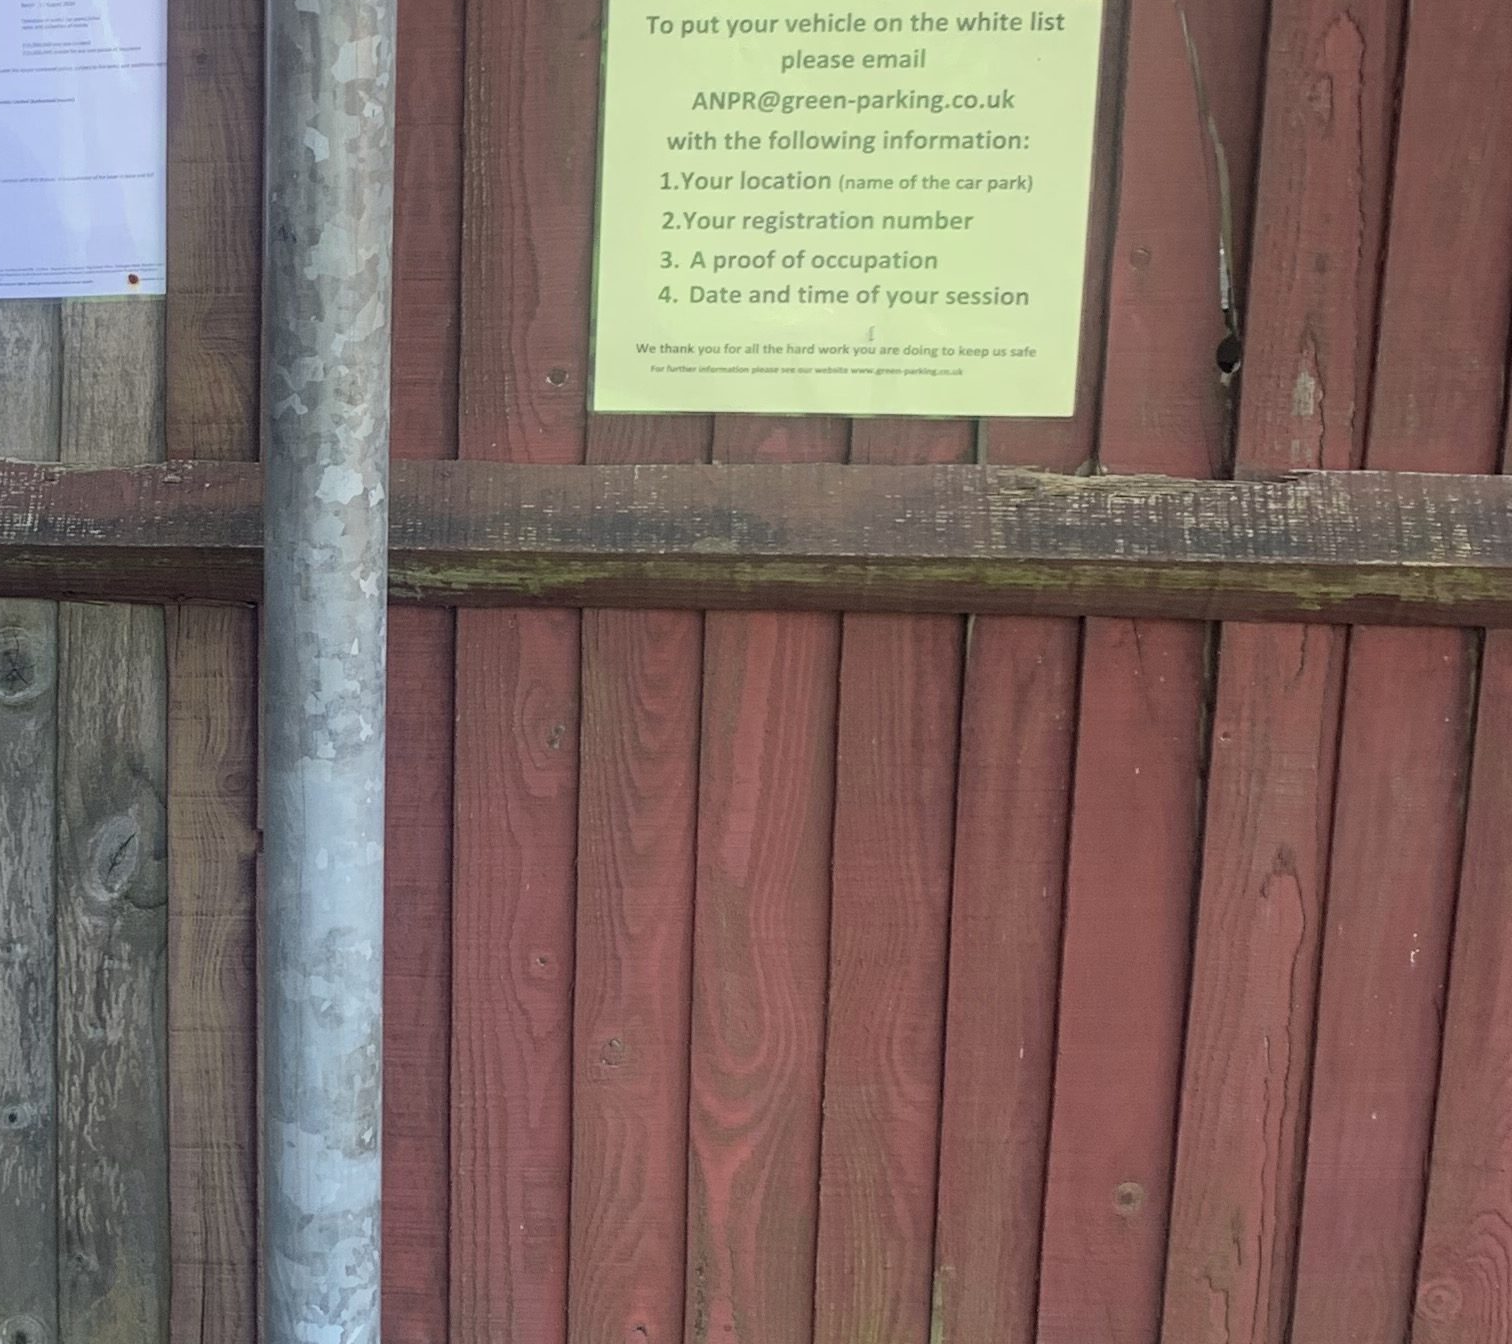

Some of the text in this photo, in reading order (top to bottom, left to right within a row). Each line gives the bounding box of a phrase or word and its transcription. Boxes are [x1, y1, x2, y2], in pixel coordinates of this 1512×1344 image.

[645, 10, 1065, 39] To put your vehicle on the white list
[780, 47, 927, 74] please email
[691, 88, 1015, 115] ANPR@green-parking.co.uk
[666, 129, 1030, 155] with the following information:
[660, 170, 1034, 194] 1.Your location (name of the car park)
[661, 209, 974, 235] 2.Your registration number
[659, 248, 938, 274] 3. A proof of occupation
[657, 284, 1030, 309] 4. Date and time of your session
[635, 342, 1037, 359] We thank you for all the hard work you are doing to keep us safe
[650, 364, 665, 373] For
[666, 364, 697, 373] further
[698, 364, 751, 374] information
[750, 366, 780, 375] please
[814, 366, 849, 375] website
